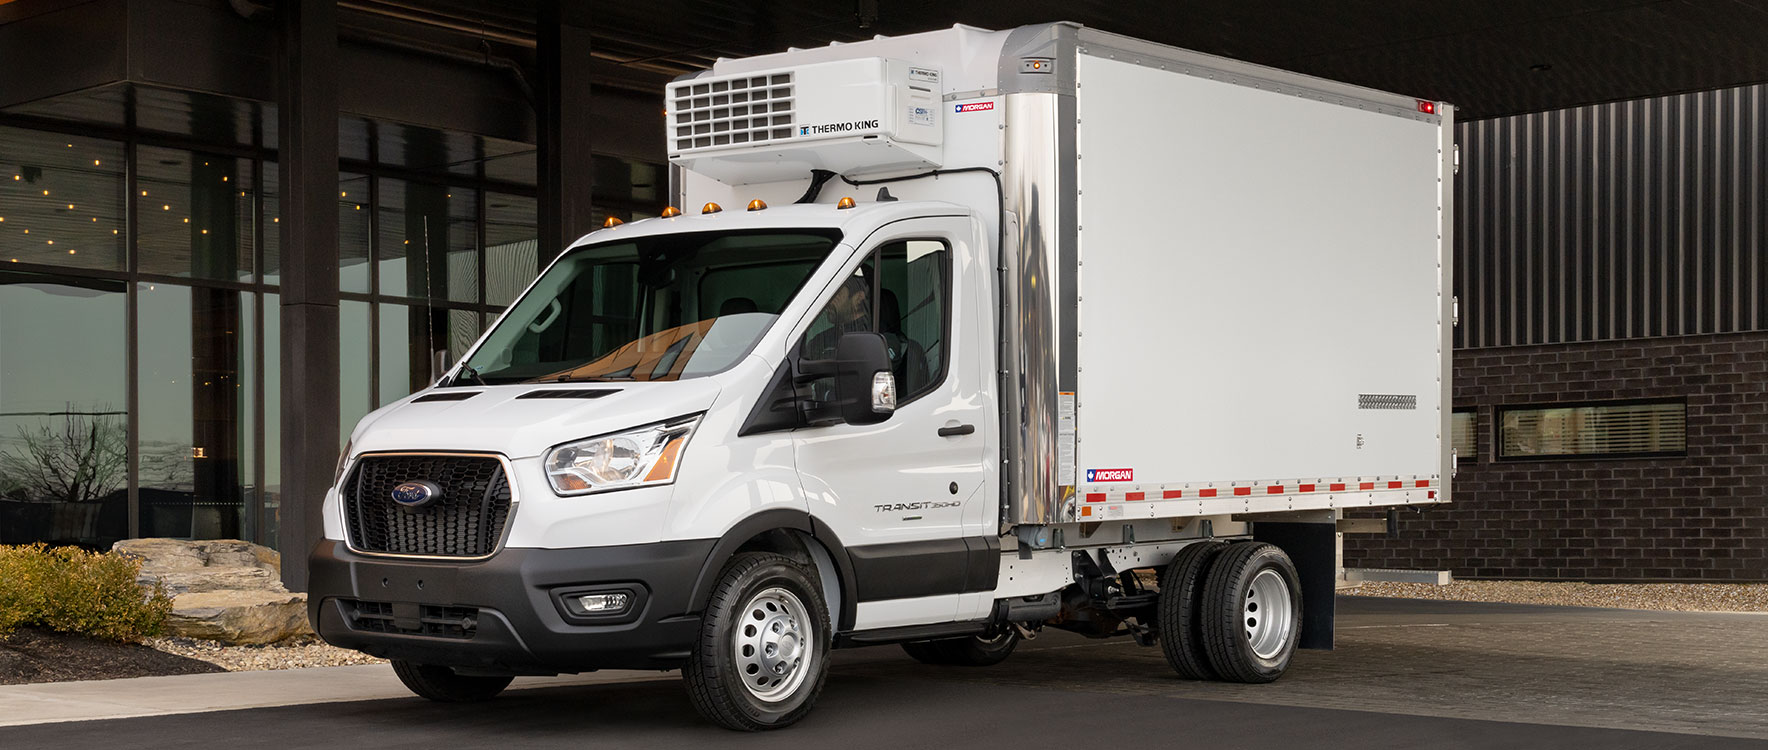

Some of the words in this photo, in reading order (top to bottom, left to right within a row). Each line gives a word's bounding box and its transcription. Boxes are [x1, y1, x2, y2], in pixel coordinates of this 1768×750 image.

[962, 103, 993, 112] MORGAN
[812, 122, 853, 134] THERMO
[854, 120, 879, 130] KING
[1095, 470, 1132, 481] MORGAN
[874, 501, 931, 512] TRANSIT
